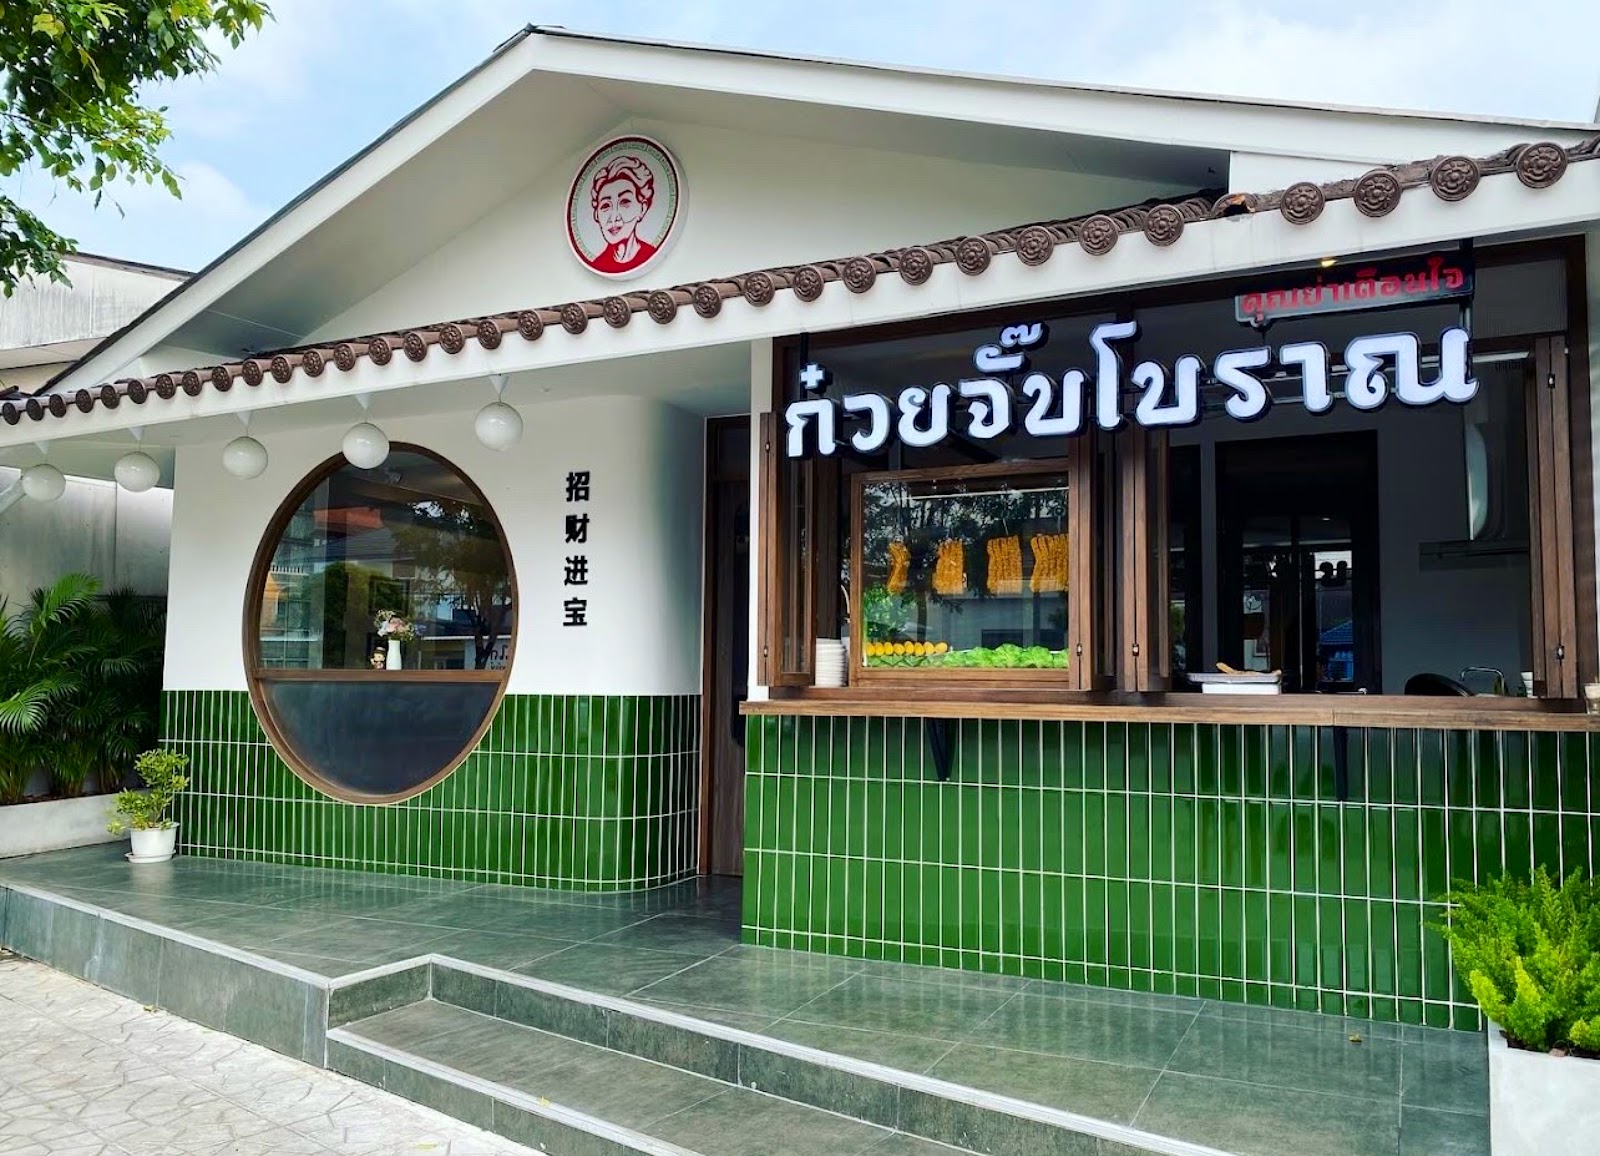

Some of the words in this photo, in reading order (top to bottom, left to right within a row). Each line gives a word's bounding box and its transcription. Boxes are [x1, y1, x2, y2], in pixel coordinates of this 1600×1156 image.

[785, 321, 1479, 458] ก๋วยจั๊บโบราณ
[562, 470, 591, 627] 招财进宝
